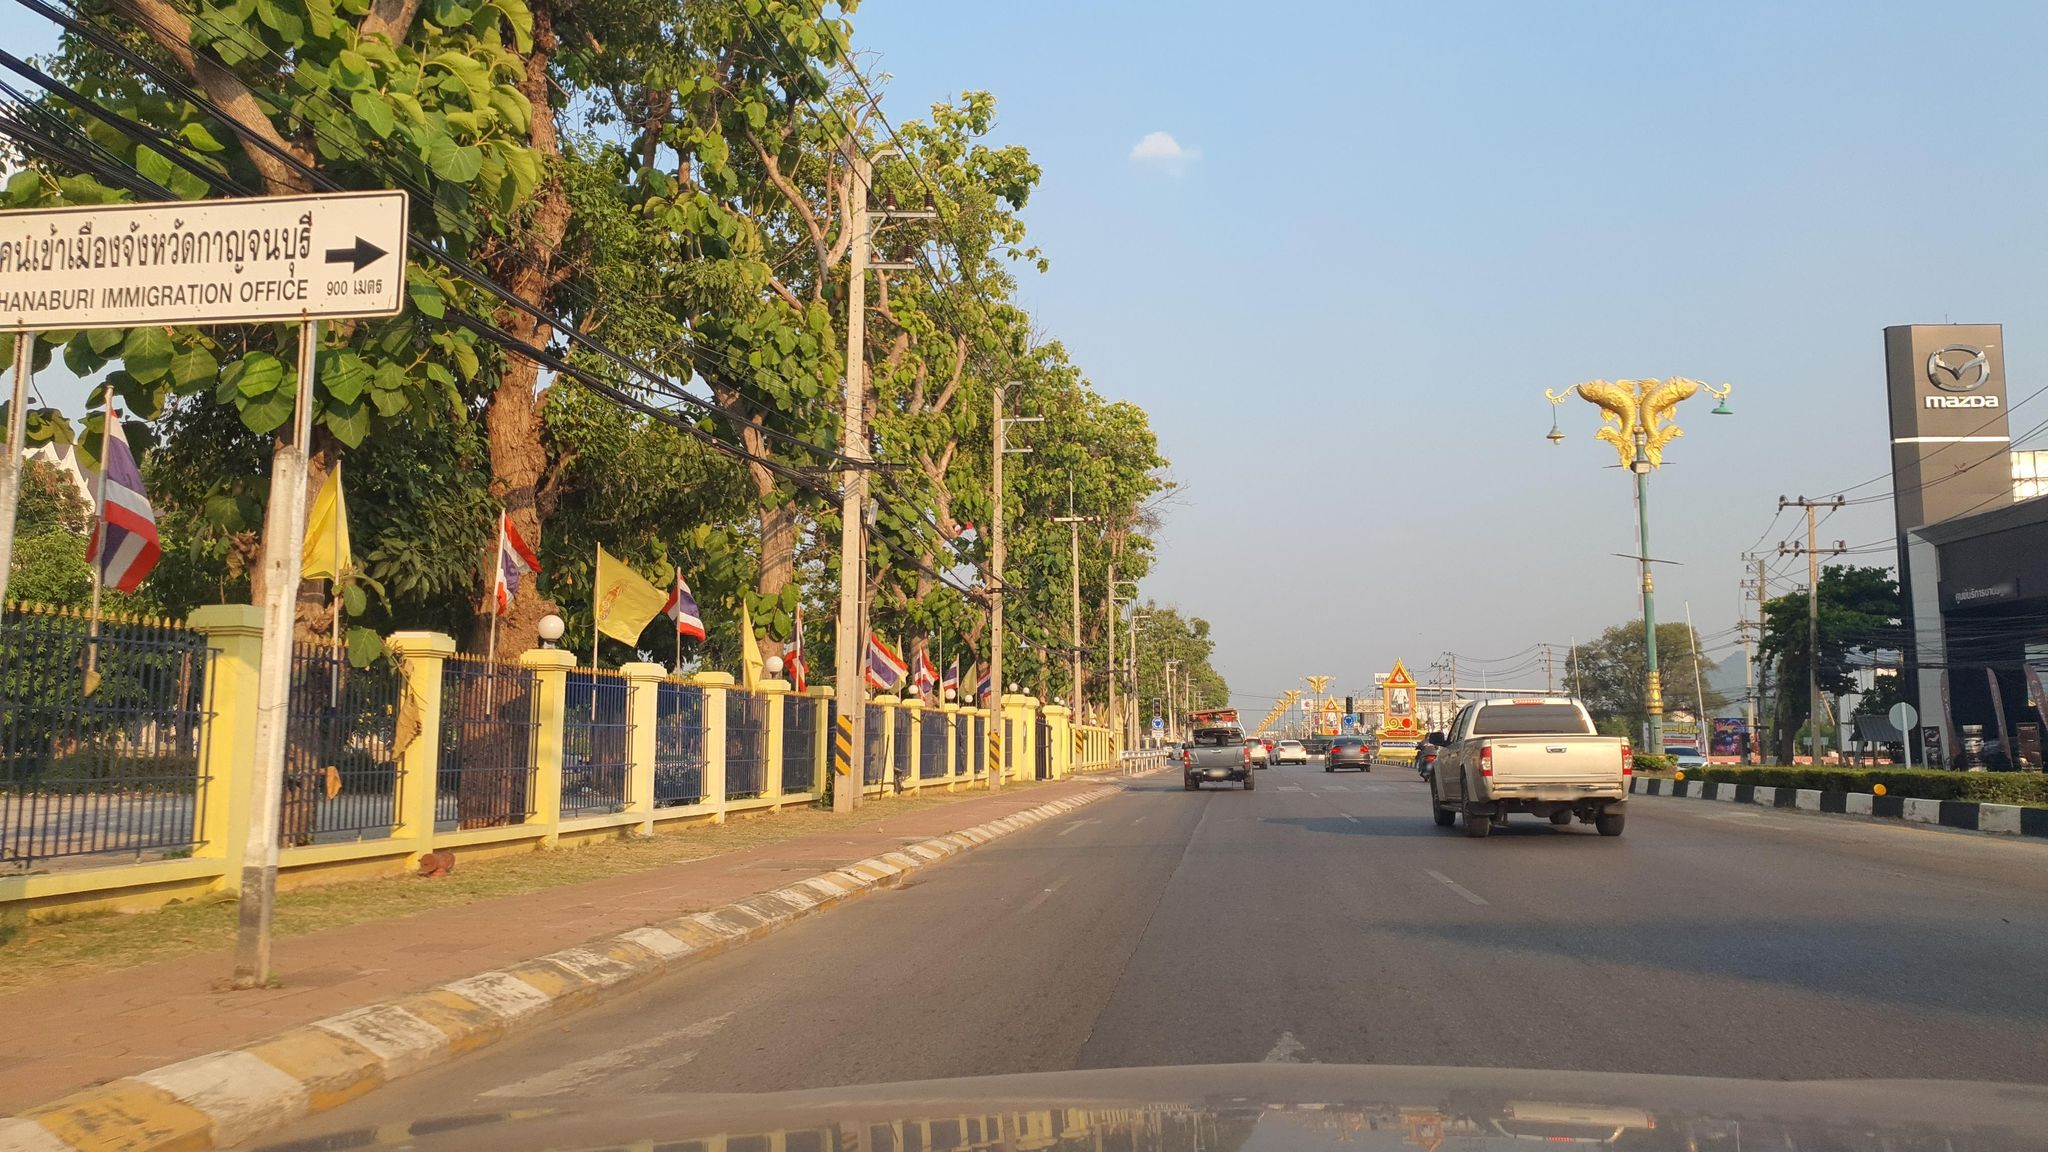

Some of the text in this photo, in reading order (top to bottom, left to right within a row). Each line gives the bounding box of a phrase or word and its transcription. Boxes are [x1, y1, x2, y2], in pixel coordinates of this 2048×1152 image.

[101, 282, 233, 308] IMMIGRATION
[241, 279, 309, 303] OFFICE
[326, 279, 384, 297] 900 เมตร
[1924, 396, 2000, 409] mazda
